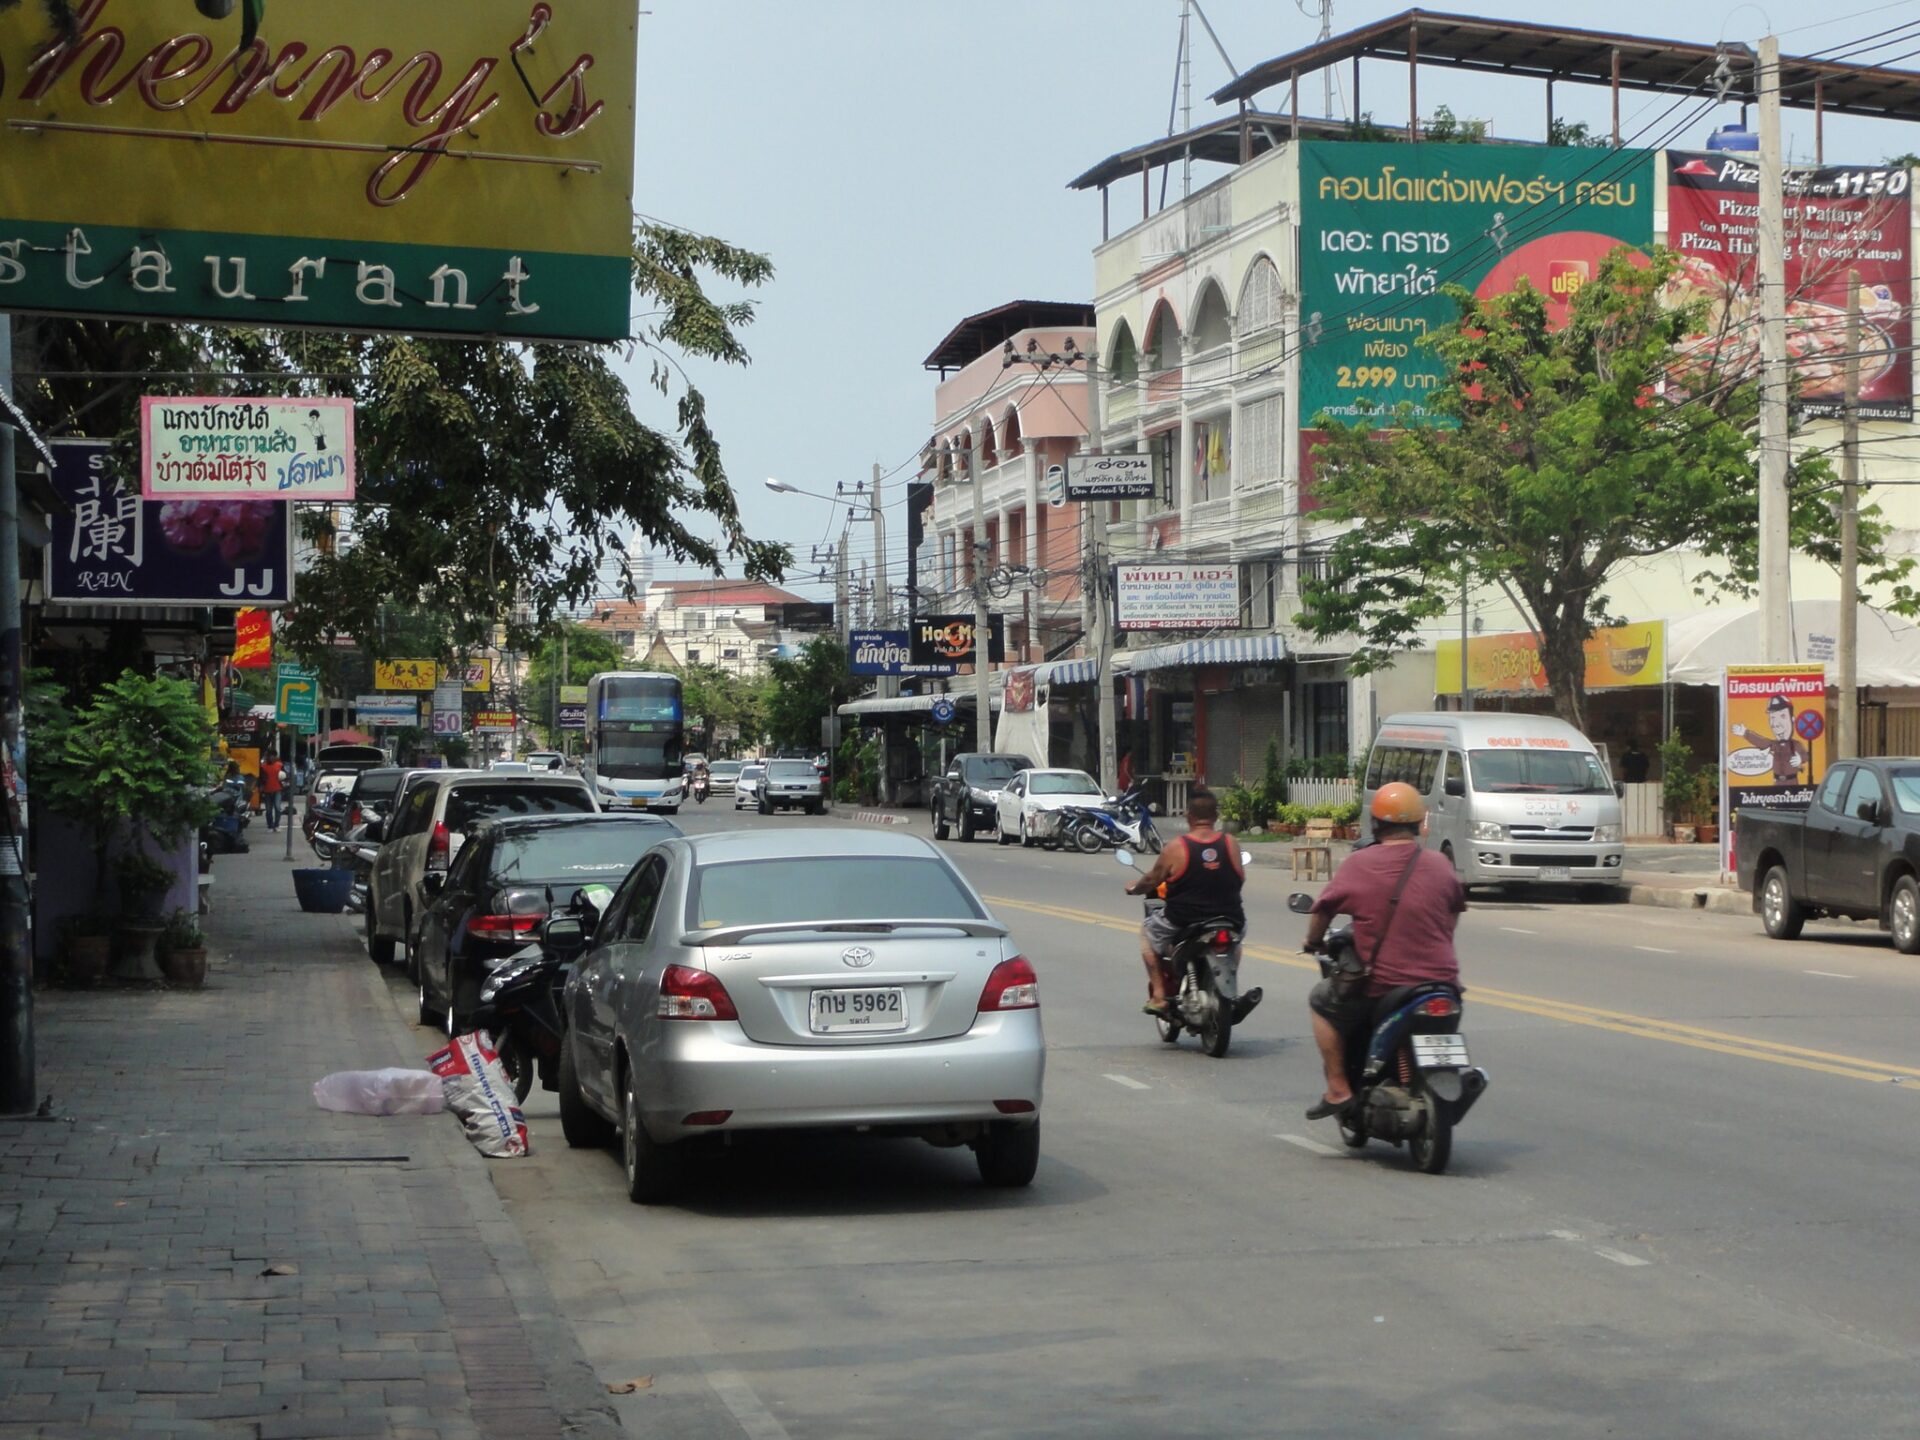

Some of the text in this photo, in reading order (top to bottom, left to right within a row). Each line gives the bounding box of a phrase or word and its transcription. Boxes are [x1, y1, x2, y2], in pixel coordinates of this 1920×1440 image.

[1718, 159, 1760, 183] Pizz
[1835, 168, 1908, 196] 1150
[1576, 182, 1635, 207] ครบ
[1718, 199, 1760, 217] Pizza
[1805, 205, 1864, 226] Pattaya
[1320, 229, 1373, 252] เดอะ
[1681, 232, 1722, 252] Pizza
[1857, 247, 1903, 261] Pattaya)
[1334, 263, 1437, 296] พัทยาใต้
[1364, 339, 1408, 358] เพียง
[1336, 366, 1437, 389] 2,999 บาท
[161, 403, 270, 431] แกงปักษ์ใต้
[179, 425, 297, 454] อาหารตามสั่ง
[1094, 457, 1147, 470] อ่อน
[69, 476, 144, 569] 蘭
[77, 570, 134, 592] RAN
[219, 567, 274, 596] JJ
[1123, 564, 1234, 581] พัทยา แอร์
[1728, 677, 1823, 694] มิตรยนต์พัทยา
[820, 993, 899, 1014] กษ 5962
